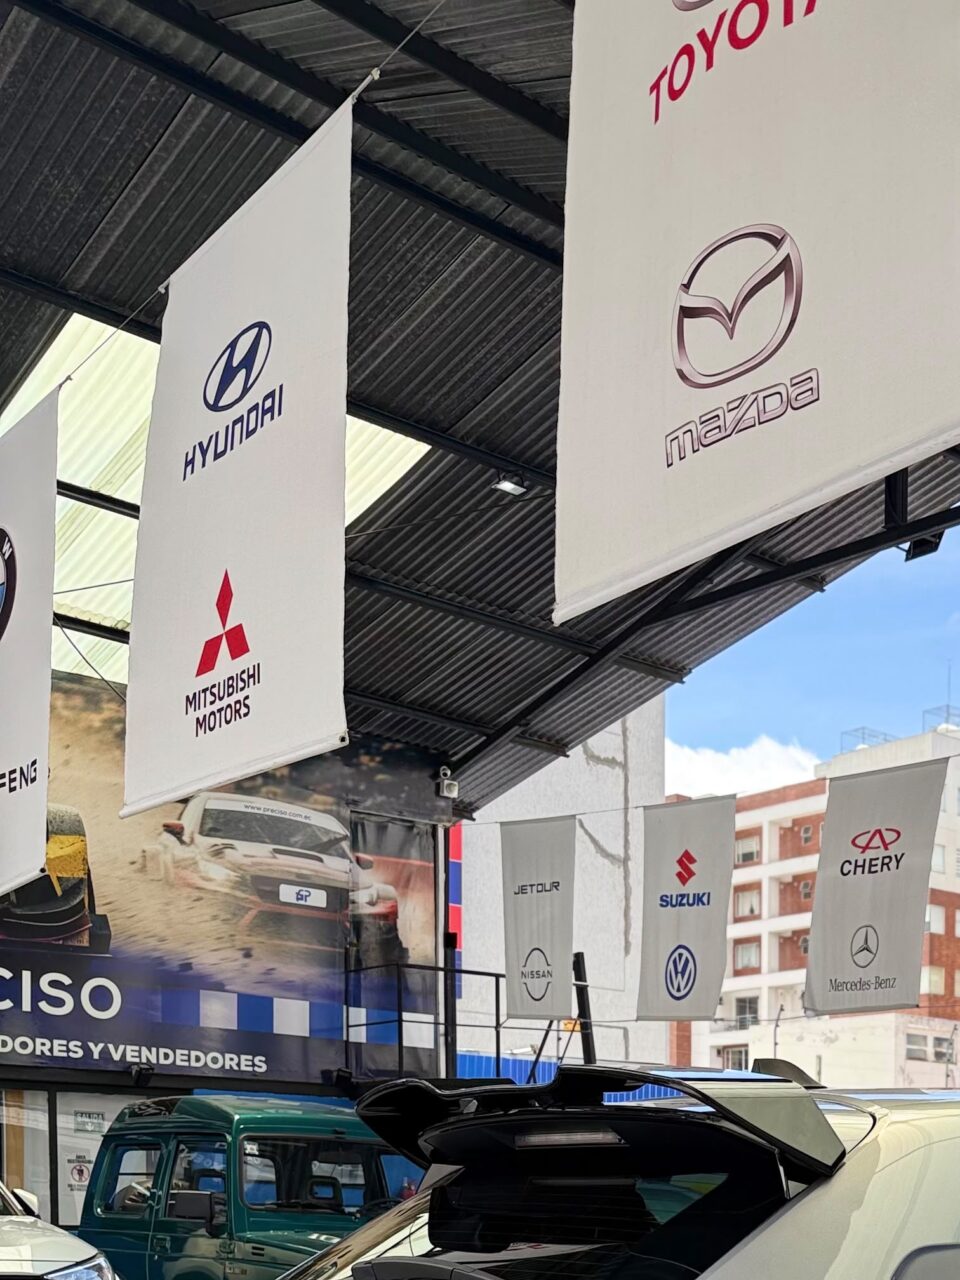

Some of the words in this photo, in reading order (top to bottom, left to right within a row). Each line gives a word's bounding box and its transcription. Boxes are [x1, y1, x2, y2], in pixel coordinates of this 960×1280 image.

[649, 0, 817, 125] TOYO
[182, 383, 284, 481] HYUNDAI
[185, 662, 261, 715] MITSUBISHI
[195, 694, 251, 737] MOTORS
[840, 852, 906, 877] CHERY
[513, 881, 560, 895] JETOUR
[659, 892, 711, 908] SUZUKI
[521, 970, 553, 979] NISSAN
[829, 975, 897, 993] Mercedes-Benz
[87, 1041, 107, 1060] Y
[107, 1043, 268, 1073] VENDEDORES
